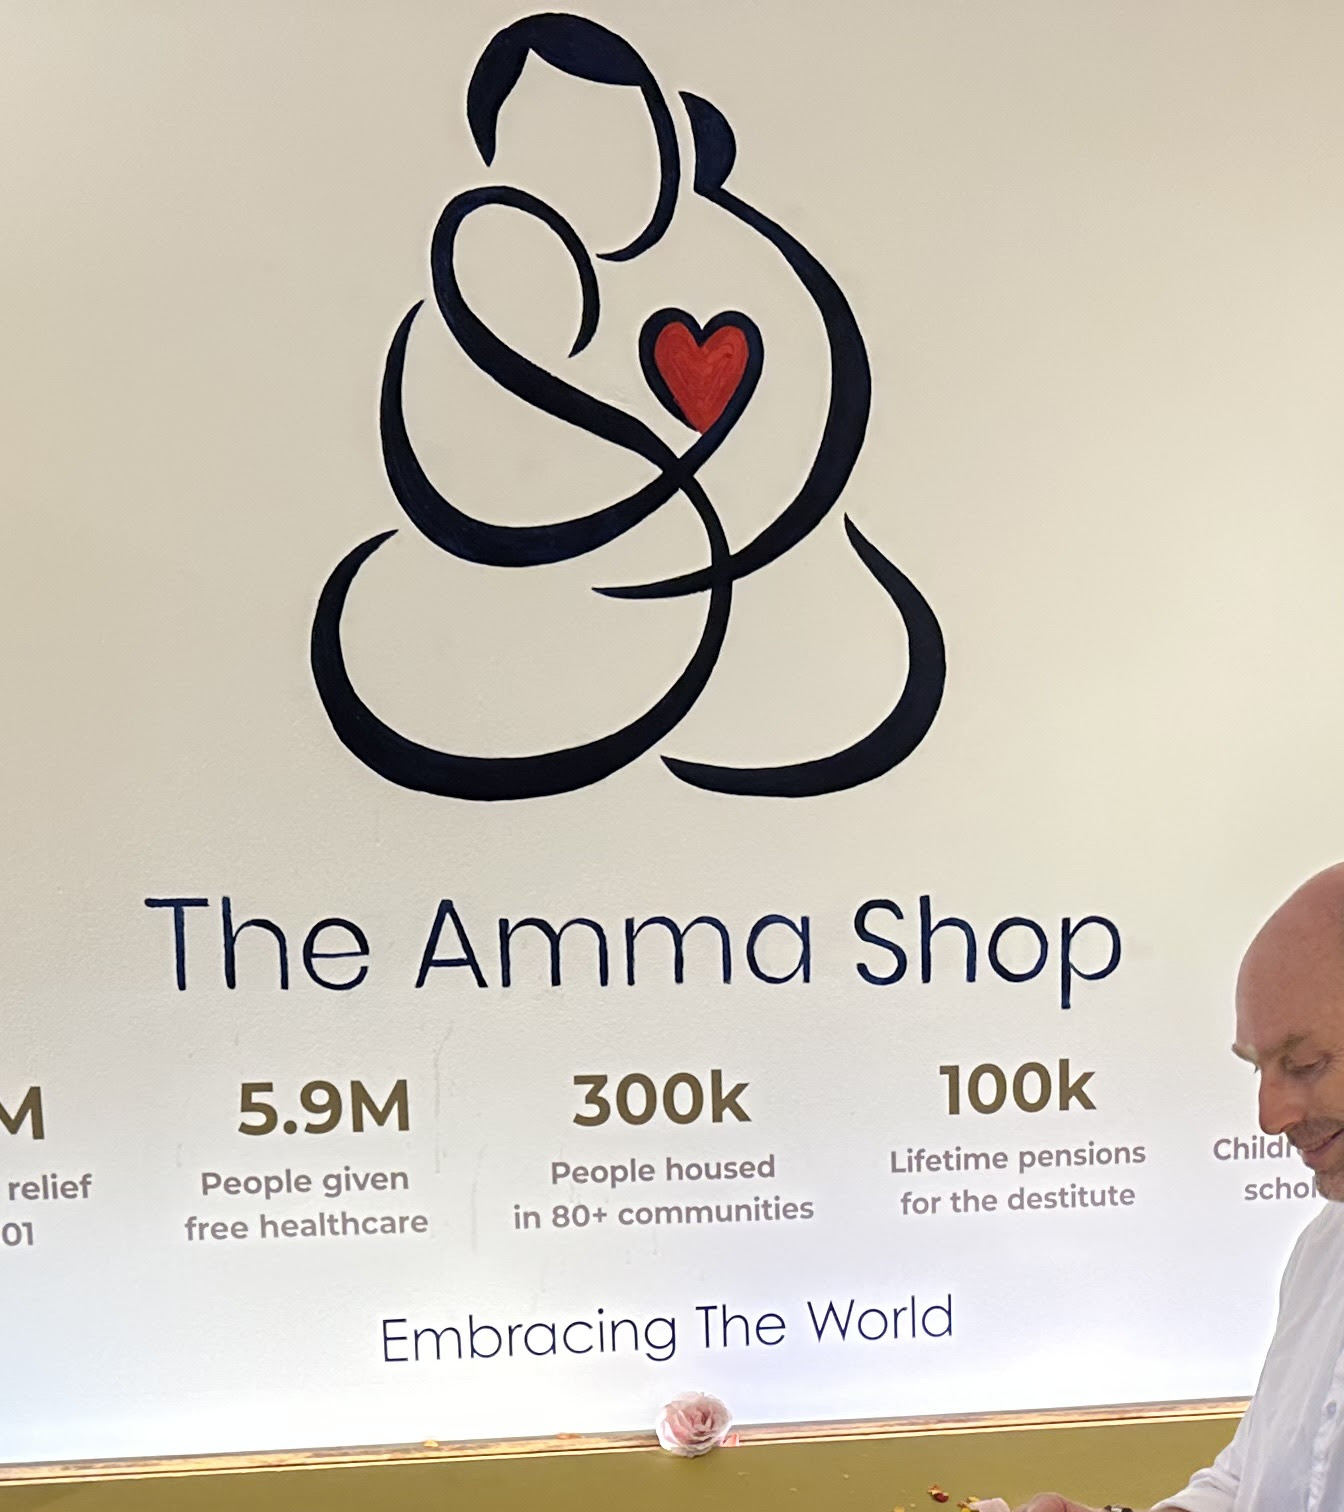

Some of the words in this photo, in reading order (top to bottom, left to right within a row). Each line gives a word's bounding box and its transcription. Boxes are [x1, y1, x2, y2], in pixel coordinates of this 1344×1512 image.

[144, 895, 371, 992] The
[414, 898, 812, 989] Amma
[853, 894, 1122, 1011] Shop
[572, 1068, 753, 1128] 300k
[939, 1058, 1097, 1116] 100k
[237, 1078, 410, 1137] 5.9M
[551, 1157, 656, 1189] People
[665, 1153, 775, 1182] housed
[890, 1145, 1009, 1175] Lifetime
[1019, 1141, 1146, 1174] pensions
[8, 1172, 93, 1202] relief
[201, 1168, 313, 1200] People
[322, 1165, 409, 1199] given
[900, 1190, 942, 1215] for
[949, 1188, 998, 1213] the
[1007, 1181, 1136, 1212] destitute
[184, 1215, 249, 1242] free
[259, 1211, 429, 1239] healthcare
[513, 1205, 541, 1230] in
[551, 1203, 608, 1229] 80+
[618, 1198, 814, 1227] communities
[382, 1307, 676, 1363] Embracing
[695, 1303, 787, 1349] The
[806, 1293, 954, 1343] World
